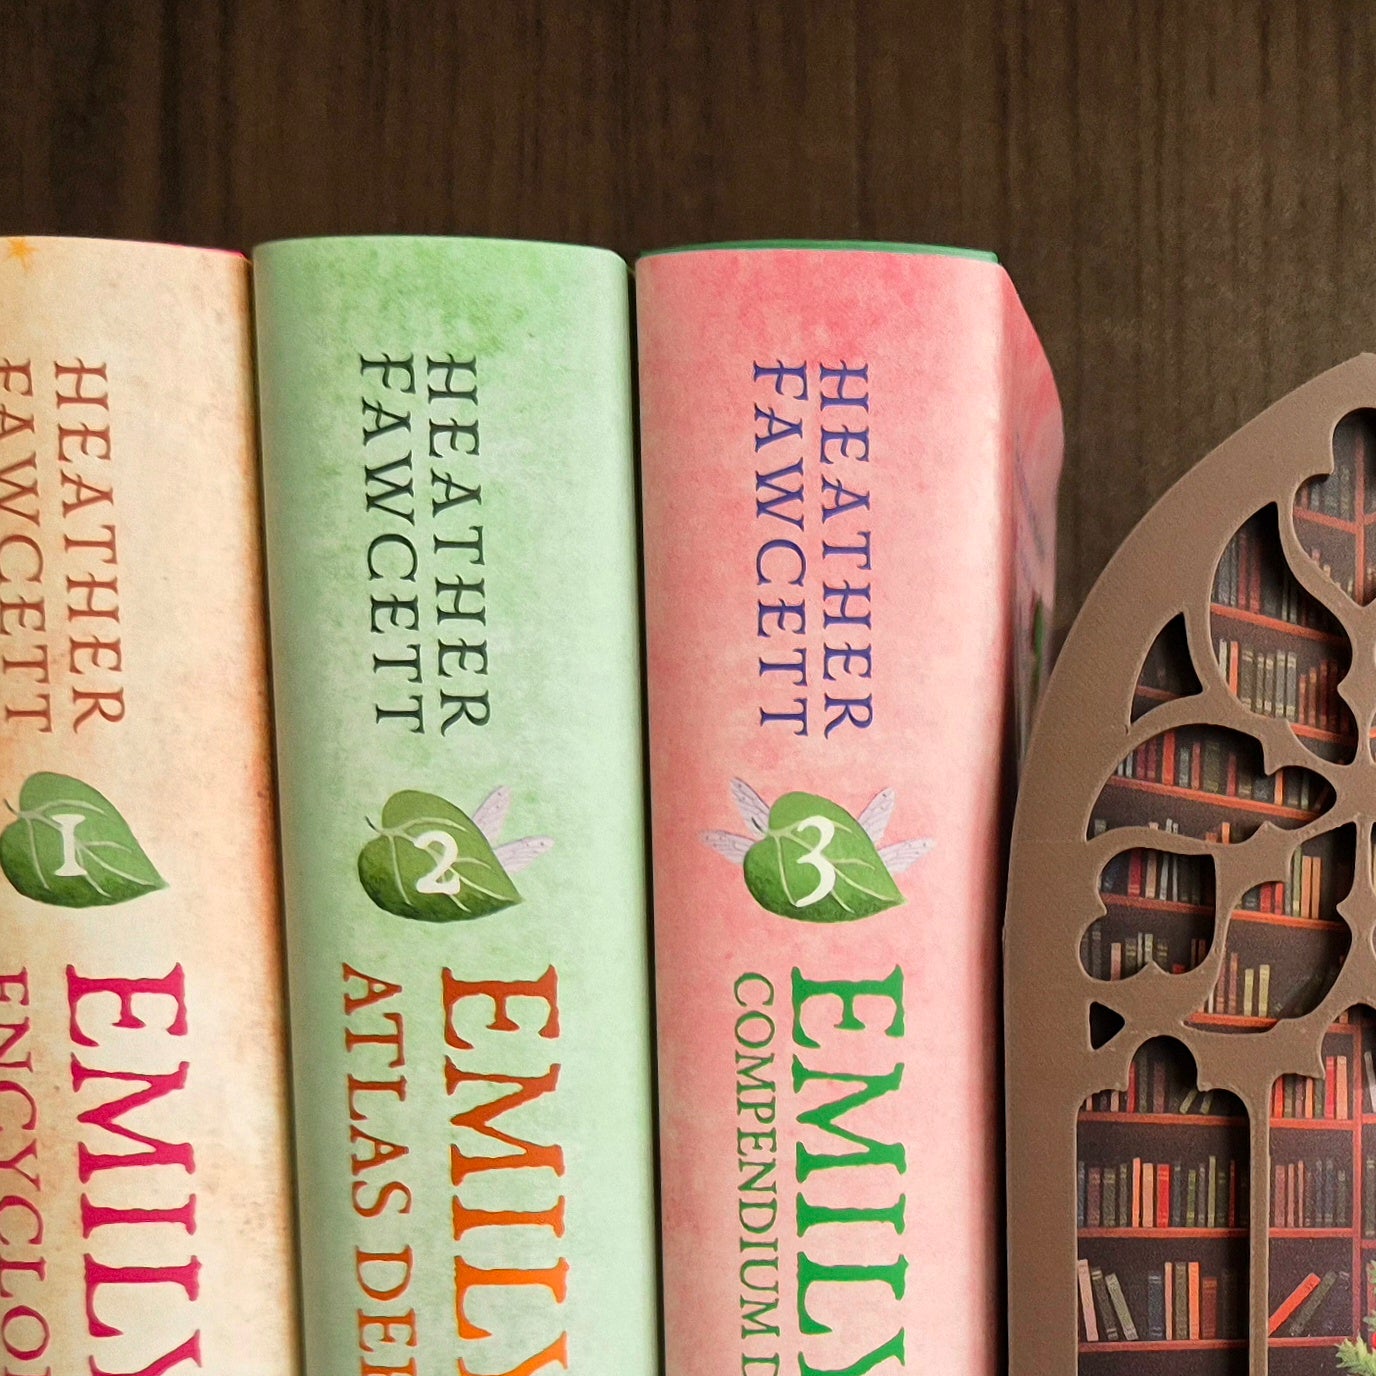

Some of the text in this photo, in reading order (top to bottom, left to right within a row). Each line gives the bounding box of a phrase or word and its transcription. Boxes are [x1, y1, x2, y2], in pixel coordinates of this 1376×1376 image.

[0, 357, 53, 733] FAWCETT
[54, 356, 126, 734] HEATHER
[359, 352, 425, 735] FAWCETT
[426, 352, 491, 737] HEATHER
[753, 358, 808, 738] FAWCETT
[818, 359, 875, 739] HEATHER
[412, 830, 462, 895] 2
[795, 815, 837, 909] 3
[341, 962, 413, 1219] ATLAS
[733, 971, 781, 1340] COMPENDIUM
